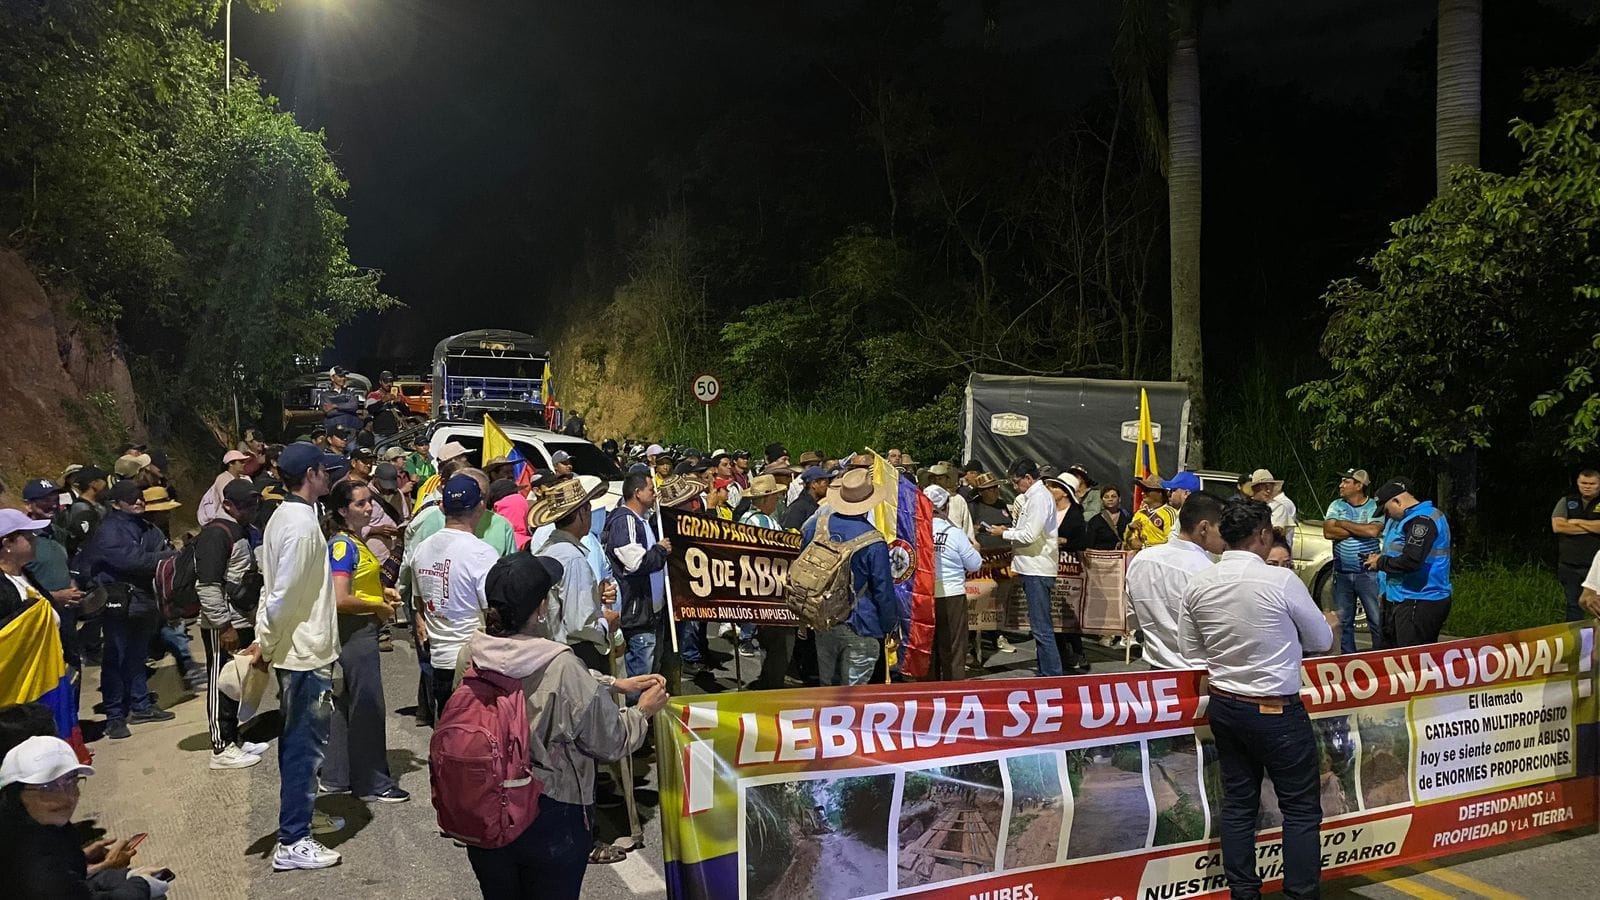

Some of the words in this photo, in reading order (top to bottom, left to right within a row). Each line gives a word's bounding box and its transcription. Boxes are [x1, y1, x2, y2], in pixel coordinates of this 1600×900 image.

[698, 381, 716, 395] 50
[677, 515, 720, 539] ¡GRAN
[721, 522, 757, 543] PARO
[758, 529, 801, 549] NACION
[685, 547, 711, 597] 9
[712, 558, 736, 587] DE
[740, 555, 788, 596] ABR
[1060, 551, 1079, 564] RIL
[681, 607, 696, 618] POR
[697, 607, 717, 618] UNOS
[718, 605, 752, 620] AVALÚOS
[754, 610, 758, 619] E
[759, 609, 800, 621] IMPUESTO
[738, 695, 989, 765] LEBRIJA
[1003, 688, 1063, 737] SE
[1078, 678, 1182, 728] UNE
[1299, 659, 1379, 705] ARO
[1384, 637, 1569, 695] NACIONAL
[1469, 693, 1478, 710] El
[1481, 690, 1523, 708] llamado
[1425, 719, 1480, 740] CATASTRO
[1483, 706, 1567, 733] MULTIPROPÓSITO
[1420, 750, 1440, 767] hoy
[1443, 749, 1456, 762] se
[1460, 742, 1491, 759] siente
[1494, 741, 1521, 753] como
[1523, 737, 1535, 748] un
[1537, 728, 1571, 746] ABUSO
[1419, 775, 1432, 790] de
[1436, 764, 1487, 787] ENORMES
[1491, 751, 1571, 777] PROPORCIONES.
[1459, 791, 1543, 821] DEFENDAMOS
[1545, 791, 1556, 804] LA
[1351, 829, 1363, 842] Y
[1433, 820, 1508, 848] PROPIEDAD
[1531, 806, 1574, 828] TIERRA
[1146, 874, 1230, 900] NUESTR
[1335, 842, 1396, 865] BARRO
